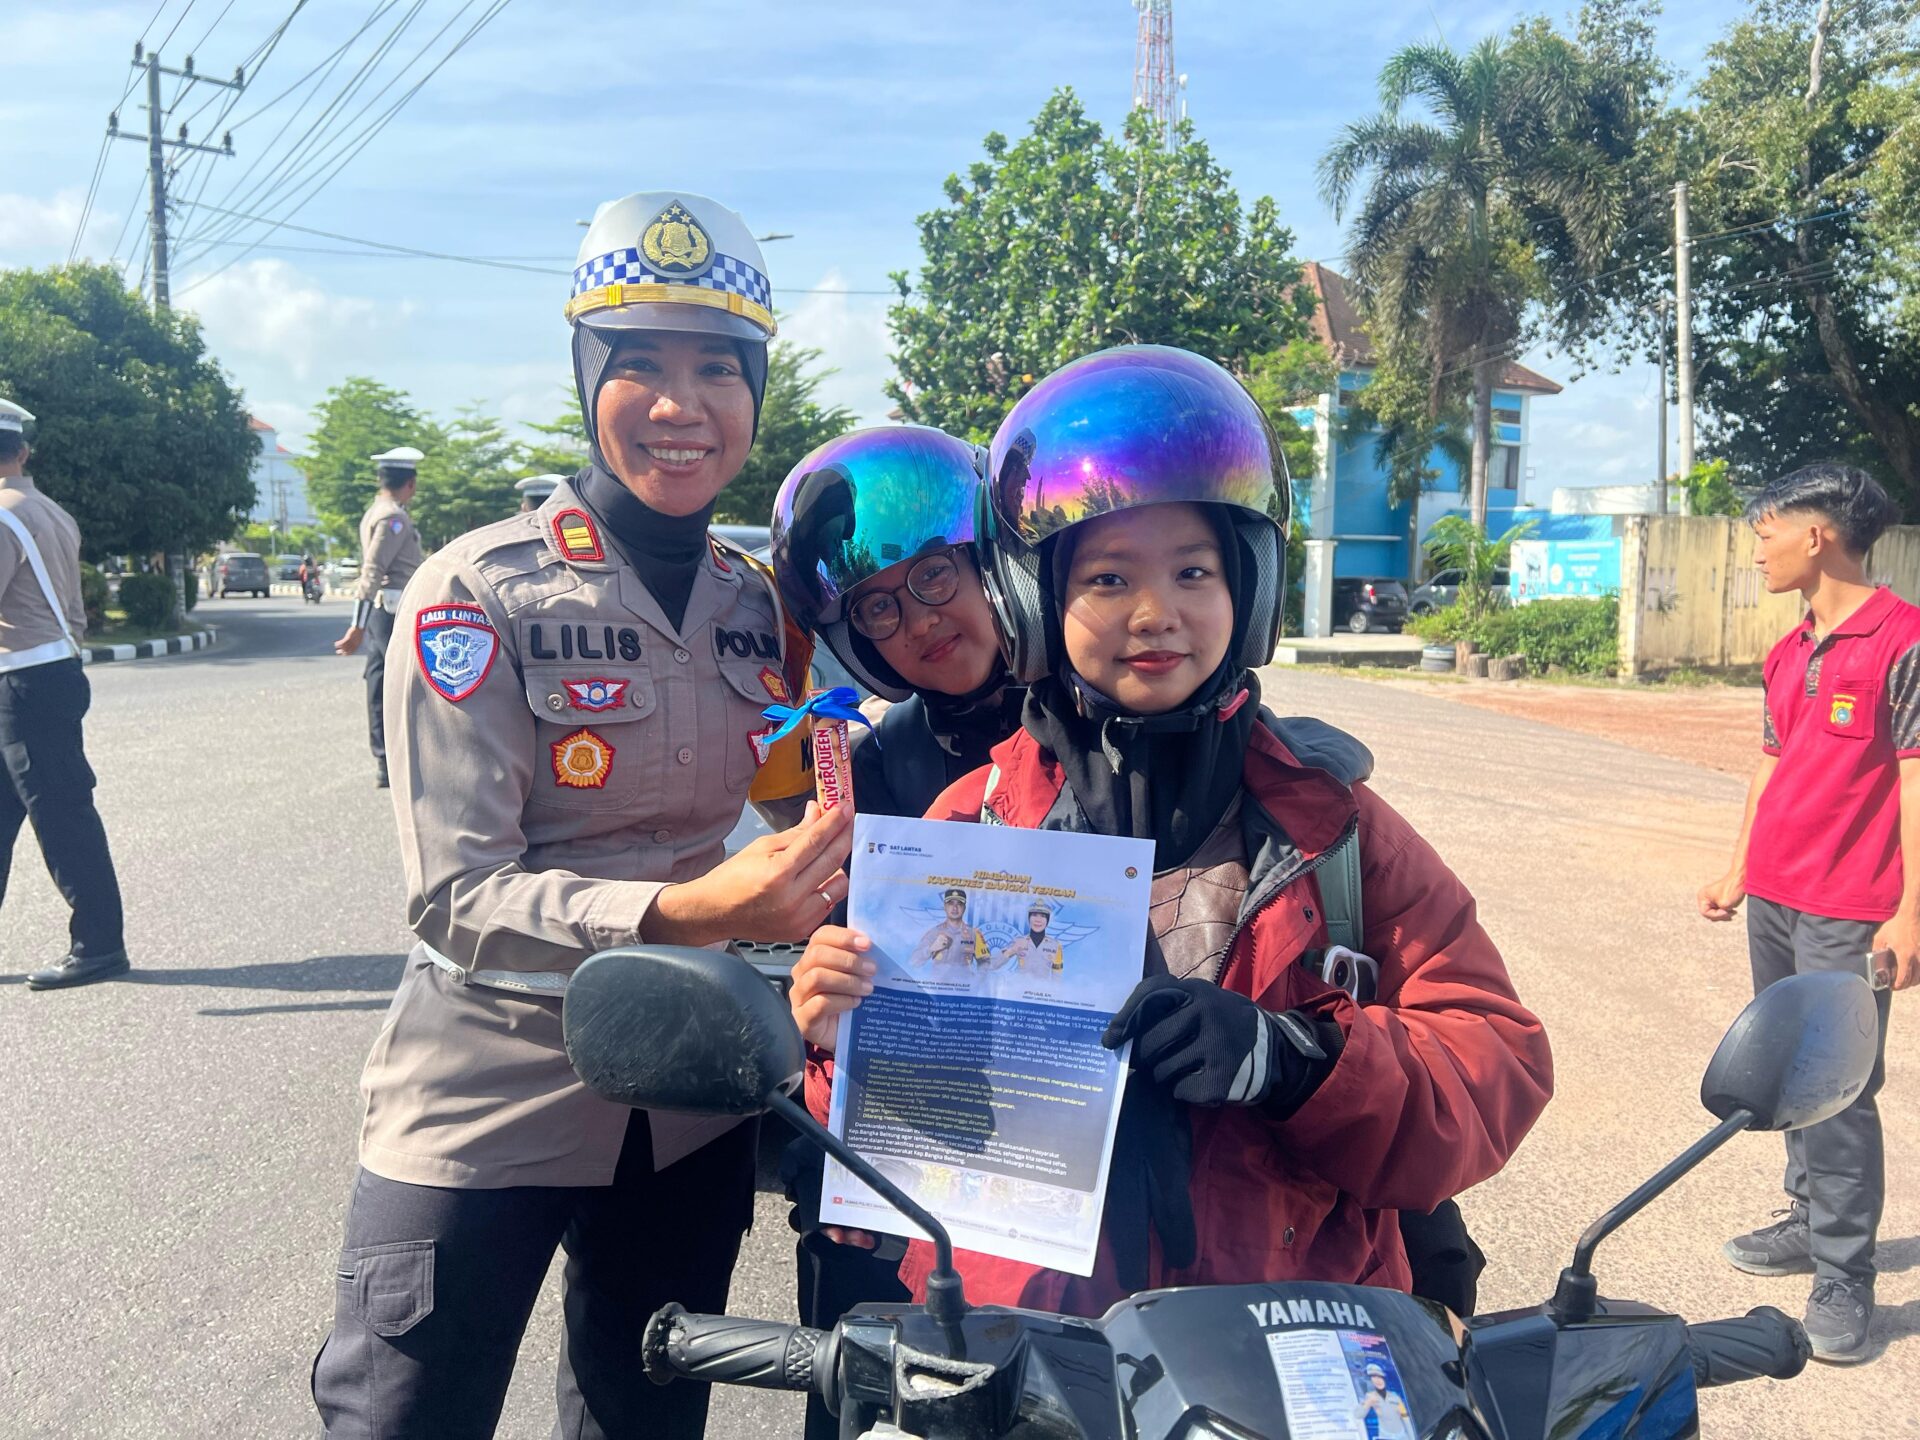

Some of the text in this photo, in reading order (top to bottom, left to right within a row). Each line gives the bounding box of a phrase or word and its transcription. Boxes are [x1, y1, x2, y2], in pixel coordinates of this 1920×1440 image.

[421, 610, 447, 624] LALU
[530, 624, 641, 661] LILIS
[838, 722, 848, 761] CHUNKY
[816, 728, 840, 811] SILVERQUEEN
[1247, 1299, 1376, 1329] YAMAHA
